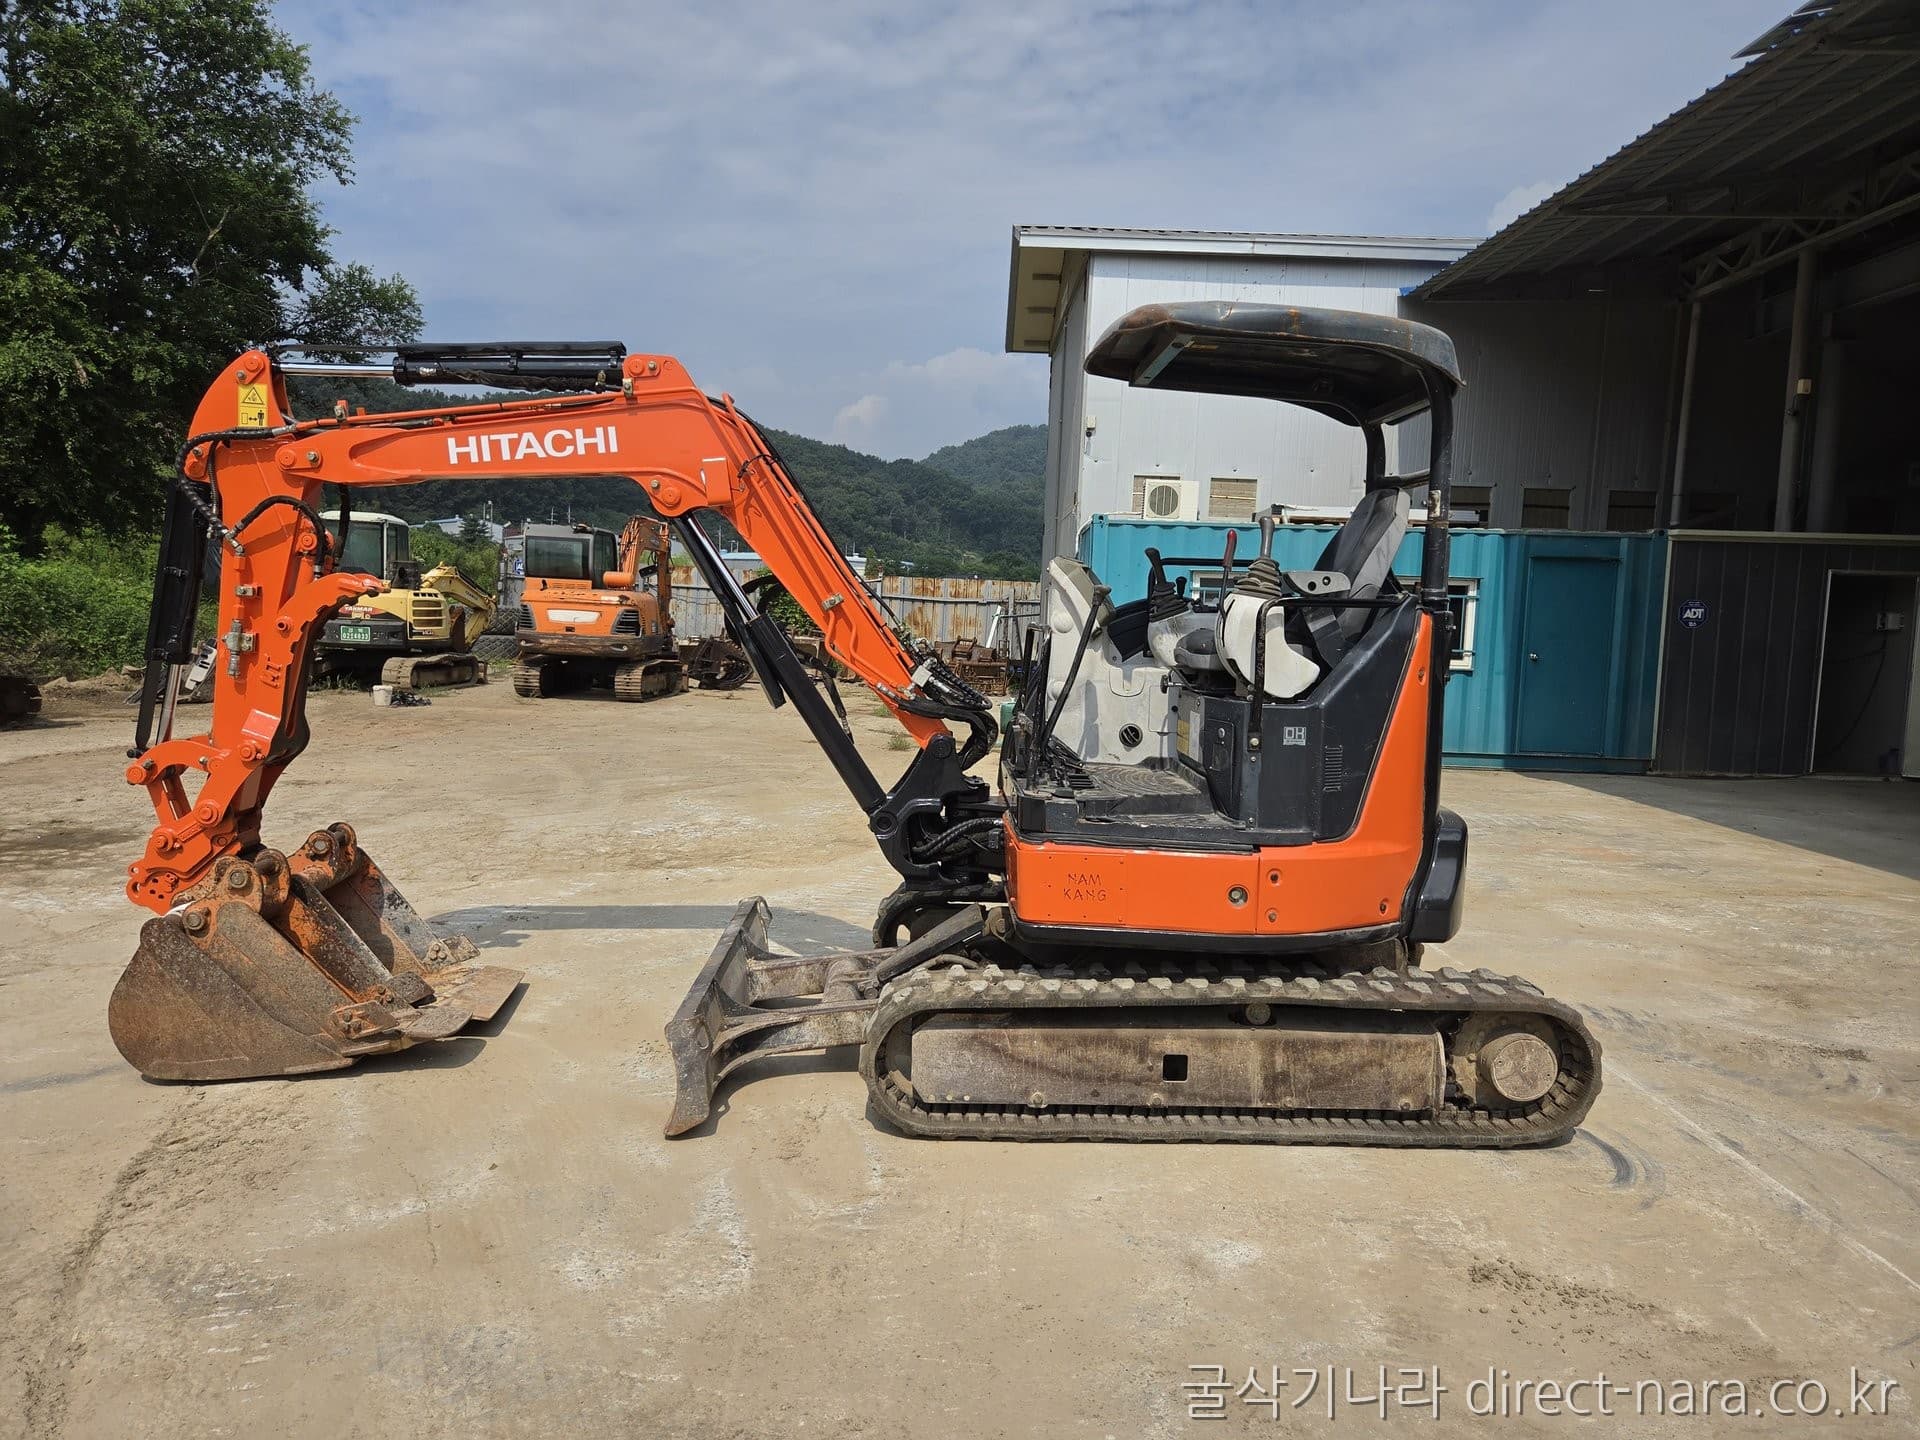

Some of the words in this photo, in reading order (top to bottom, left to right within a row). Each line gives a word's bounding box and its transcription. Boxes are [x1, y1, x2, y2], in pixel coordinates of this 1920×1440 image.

[447, 425, 618, 465] HITACHI
[1683, 608, 1704, 619] ADT
[1067, 873, 1102, 886] NAM
[1063, 888, 1106, 902] KANG
